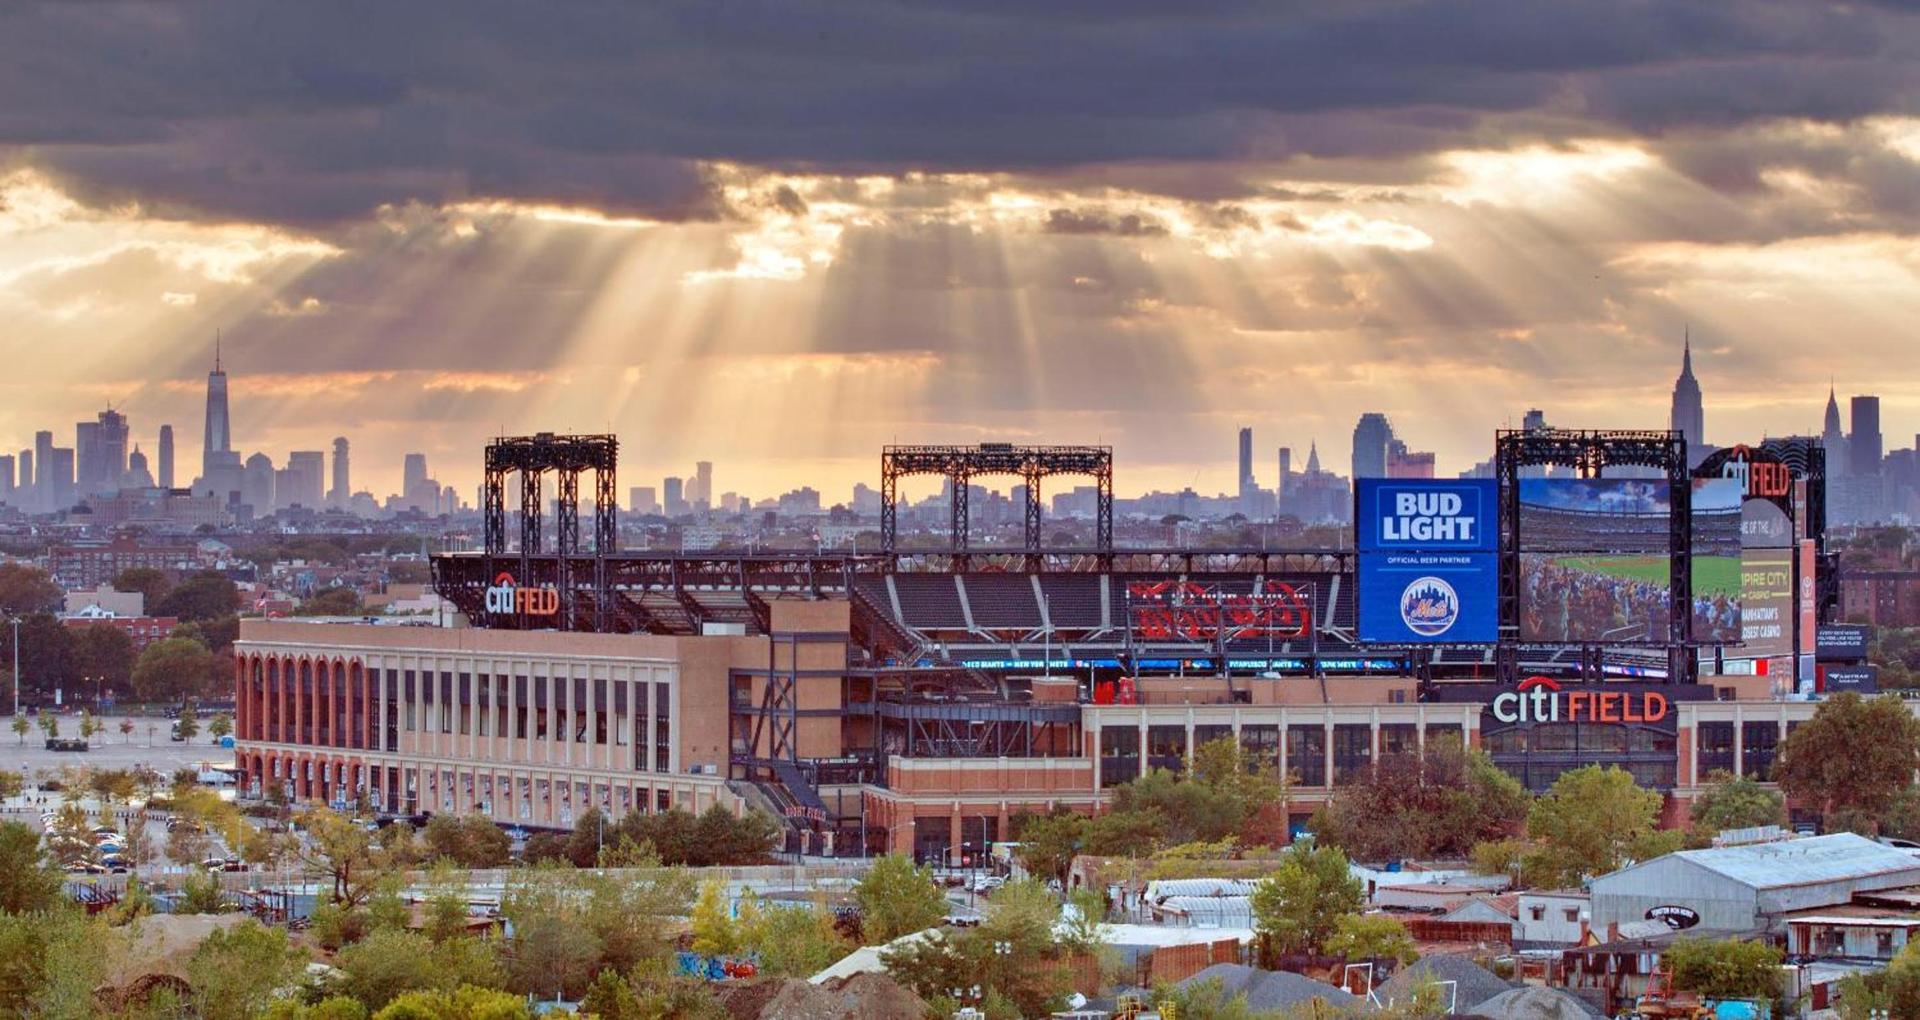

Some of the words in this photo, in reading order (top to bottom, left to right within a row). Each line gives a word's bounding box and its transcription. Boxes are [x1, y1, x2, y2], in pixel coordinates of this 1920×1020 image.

[1751, 462, 1790, 496] FIELD
[1396, 493, 1462, 517] BUD
[1383, 517, 1475, 541] LIGHT
[1387, 556, 1419, 564] OFFICIAL
[1420, 556, 1438, 564] BEER
[1439, 556, 1472, 564] PARTNER
[1741, 572, 1766, 587] PIRE
[1767, 571, 1788, 587] CITY
[485, 579, 514, 614] citi
[516, 587, 560, 615] FIELD
[1493, 684, 1558, 723] citi
[1568, 692, 1667, 722] FIELD
[807, 806, 826, 821] FIELD
